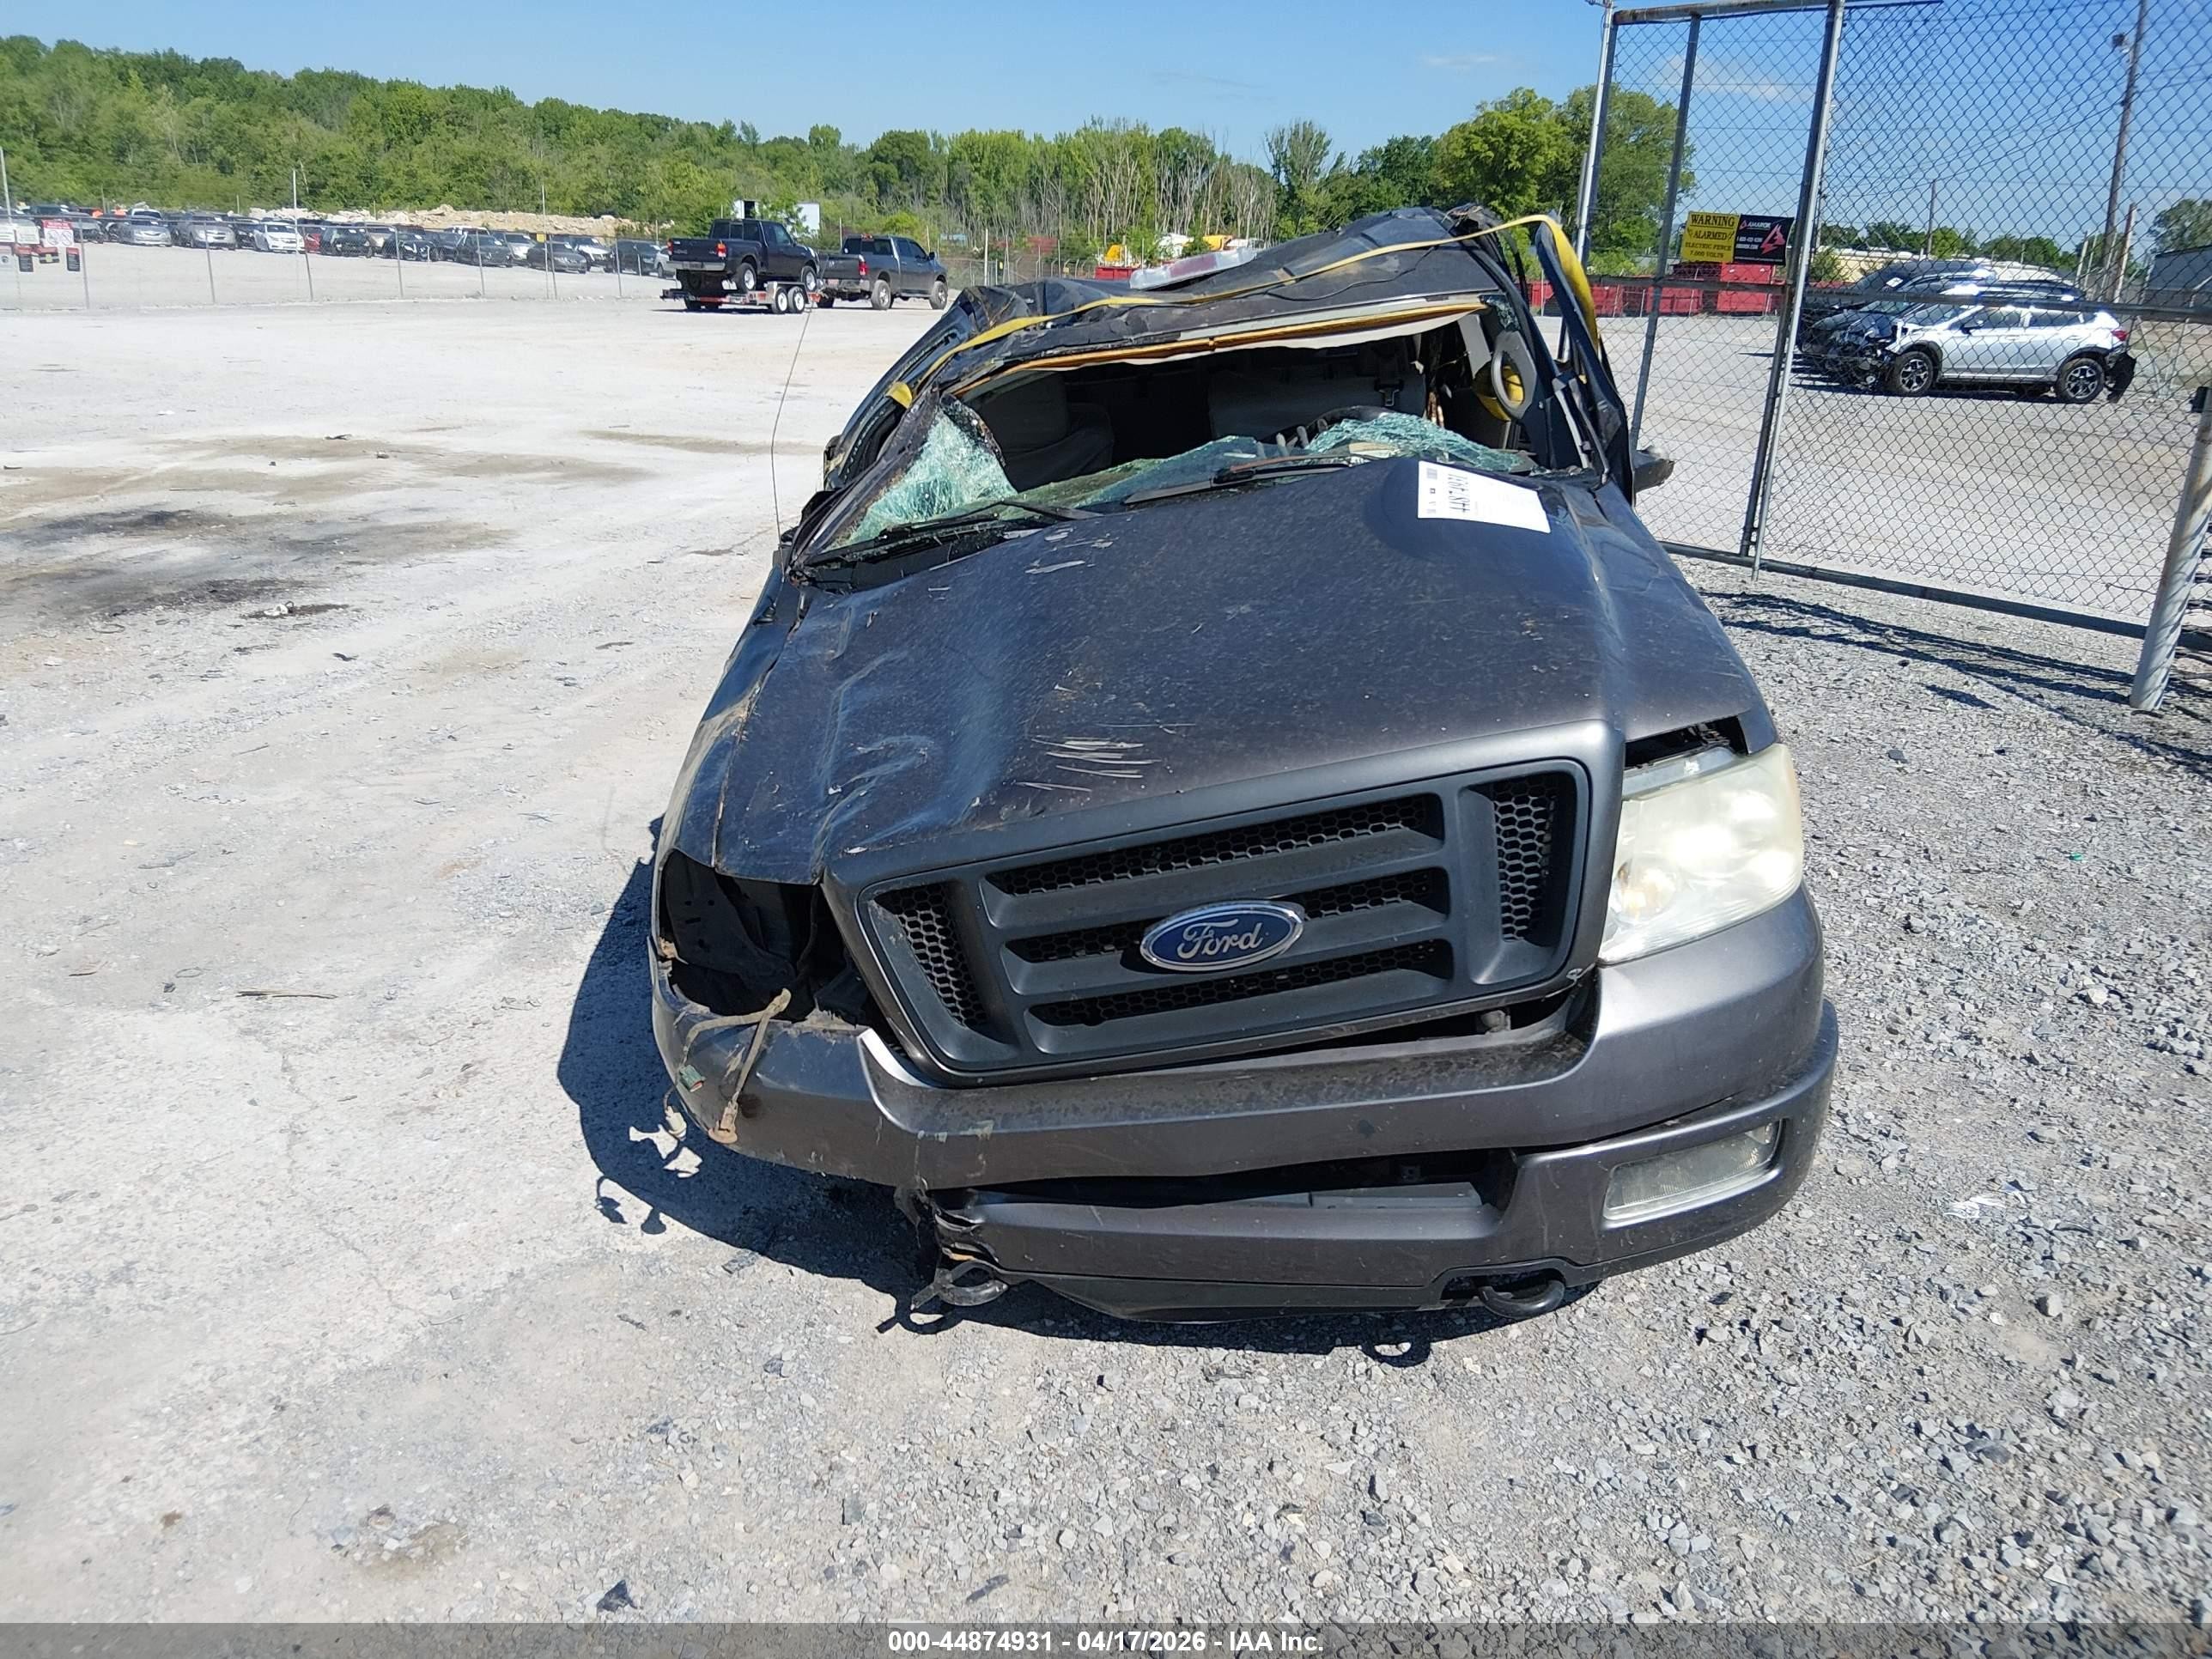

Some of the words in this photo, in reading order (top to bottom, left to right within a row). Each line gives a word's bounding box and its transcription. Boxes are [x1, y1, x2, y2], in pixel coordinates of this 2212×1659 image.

[1691, 214, 1735, 227] WARNING
[1693, 229, 1727, 240] ALARMED
[1176, 918, 1265, 959] Ford
